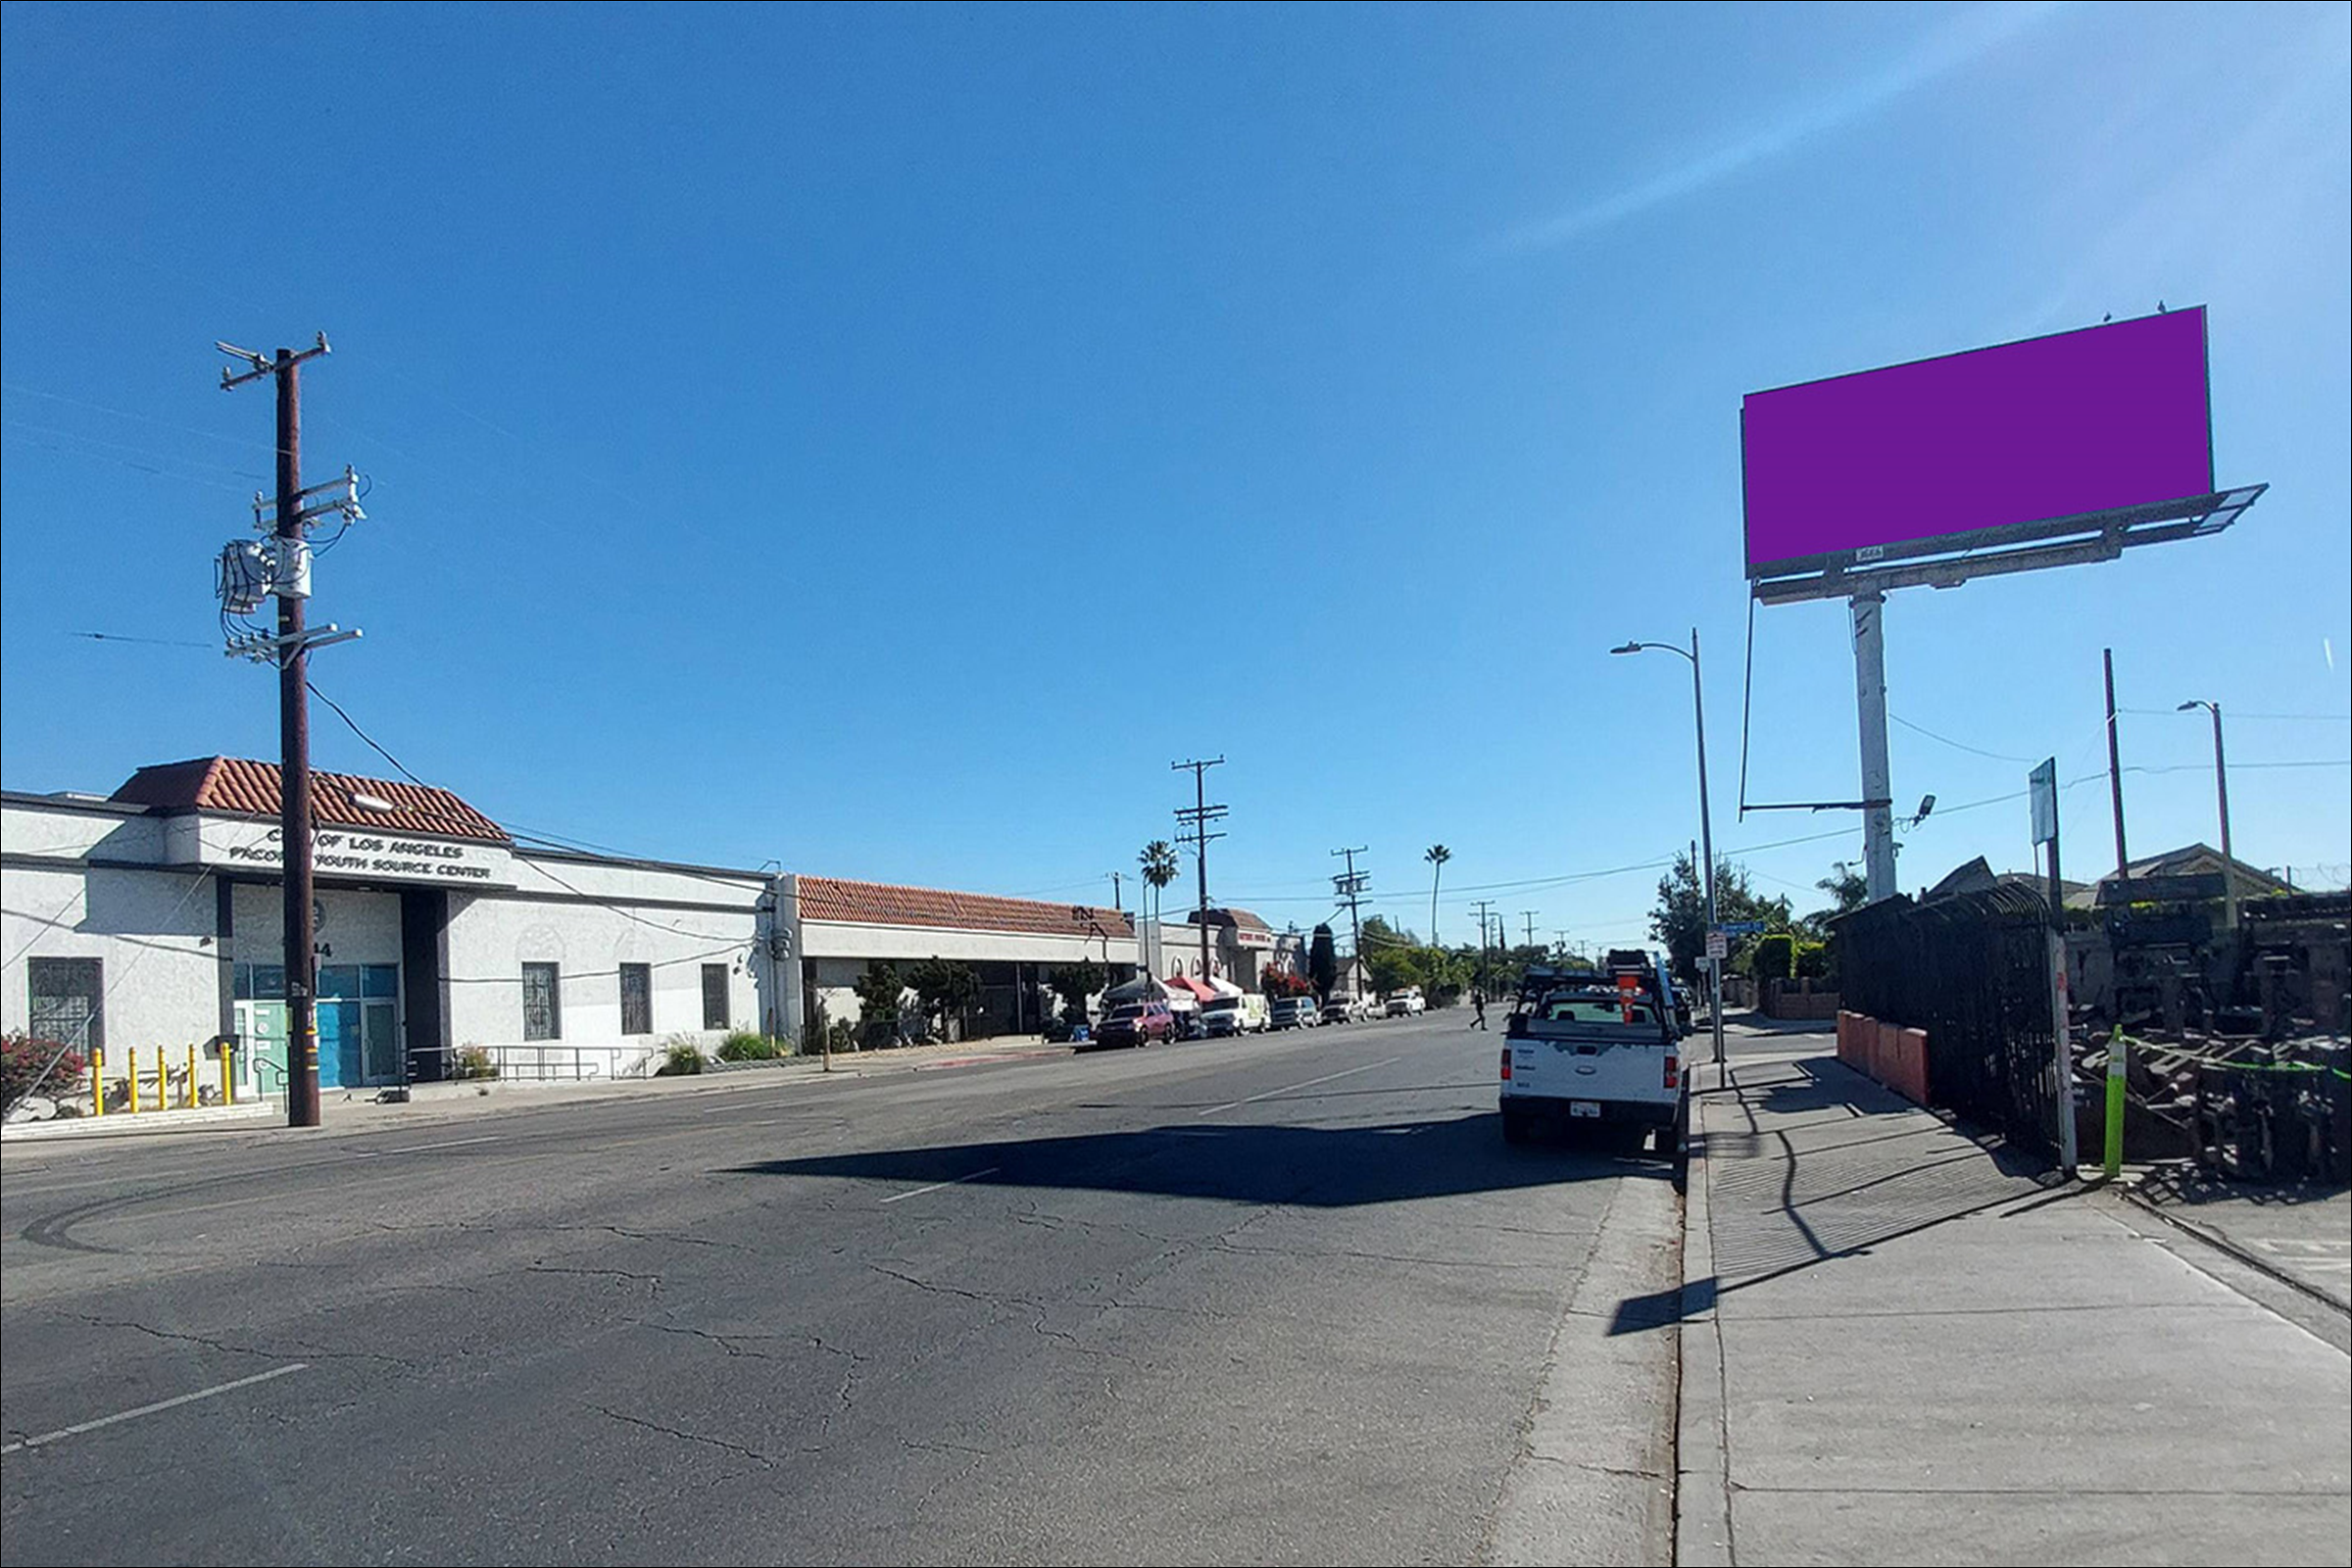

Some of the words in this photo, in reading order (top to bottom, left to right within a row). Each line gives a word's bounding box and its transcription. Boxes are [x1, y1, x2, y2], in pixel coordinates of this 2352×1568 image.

[318, 834, 344, 848] OF
[349, 837, 384, 852] LOS
[389, 842, 464, 858] ANGELES
[315, 855, 368, 870] YOUTH
[372, 859, 432, 874] SOURCE
[437, 864, 491, 878] CENTER
